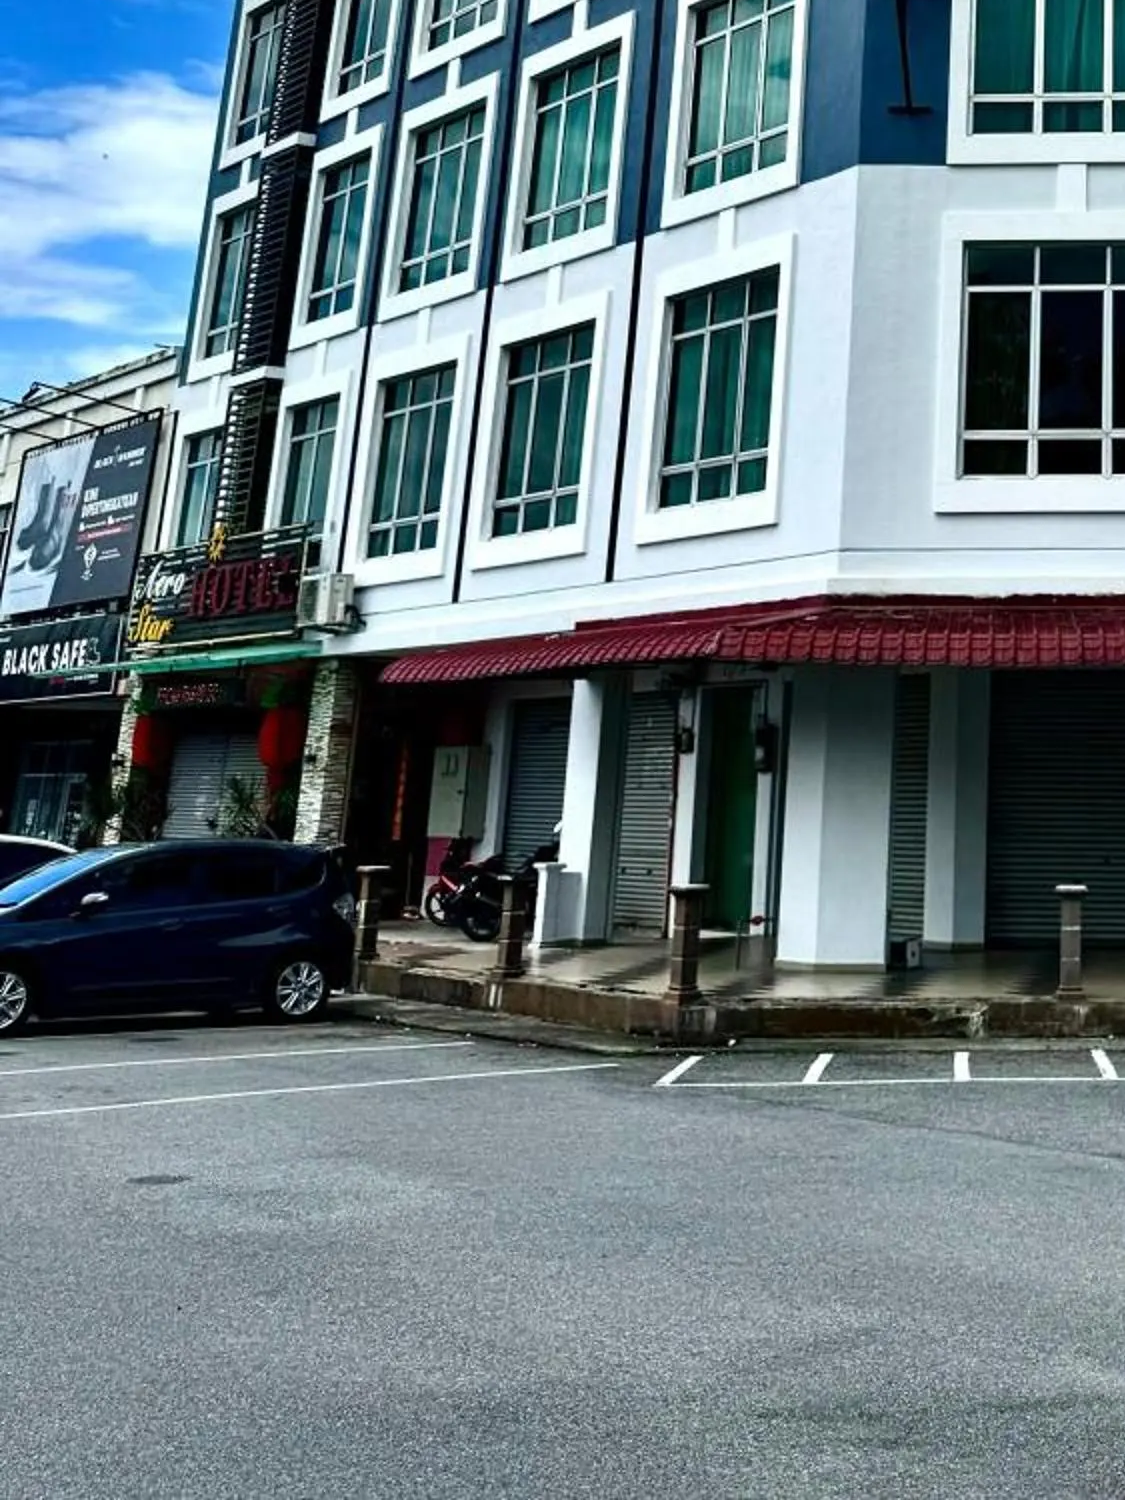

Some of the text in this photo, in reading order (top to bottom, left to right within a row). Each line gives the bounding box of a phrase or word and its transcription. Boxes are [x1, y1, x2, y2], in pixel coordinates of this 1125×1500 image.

[134, 560, 186, 600] Aero
[187, 555, 295, 617] HOTEL
[128, 603, 174, 642] Star
[1, 639, 88, 676] BLACK SAFE
